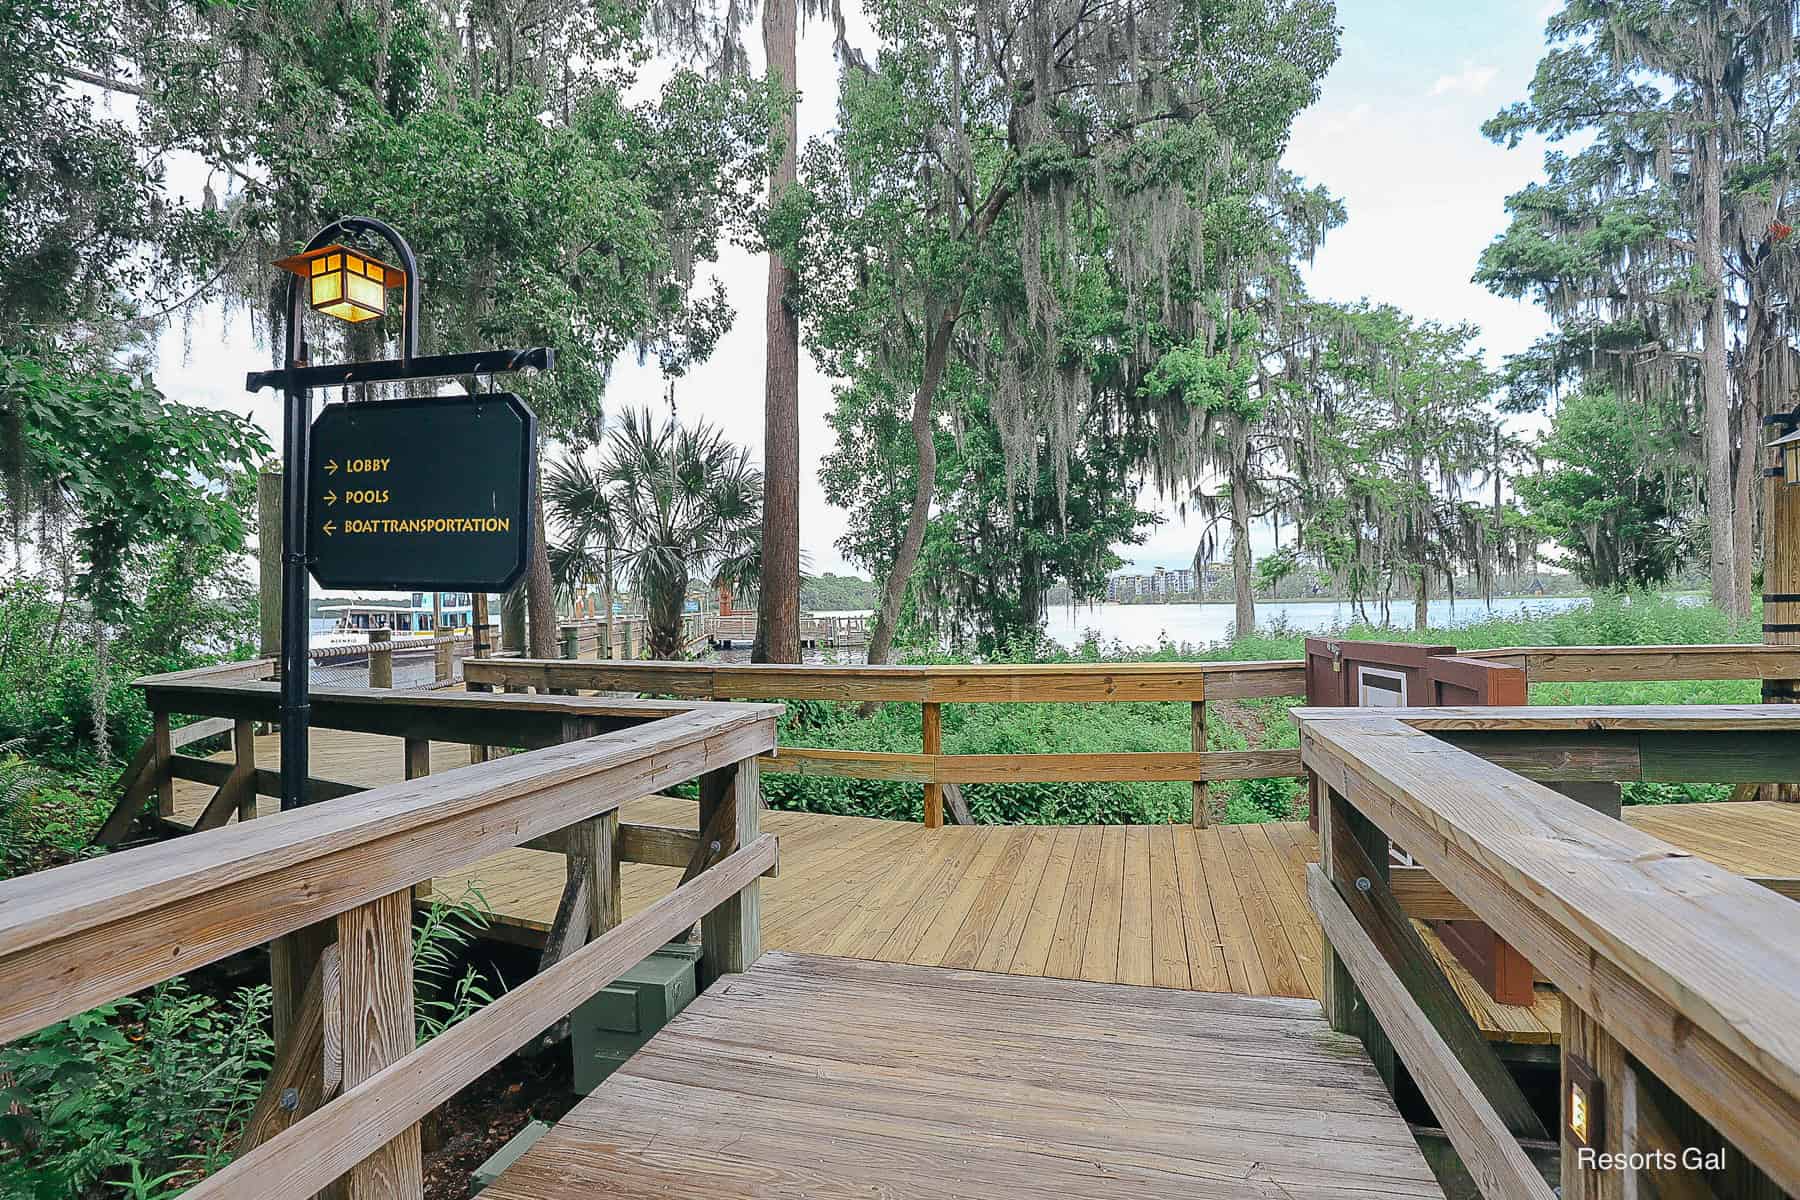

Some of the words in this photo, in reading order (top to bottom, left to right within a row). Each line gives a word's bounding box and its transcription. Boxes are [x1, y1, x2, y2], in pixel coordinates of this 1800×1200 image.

[347, 458, 390, 473] LOBBY
[345, 490, 389, 504] POOLS
[344, 519, 380, 533] BOAT
[382, 518, 510, 533] TRANSPORTATION
